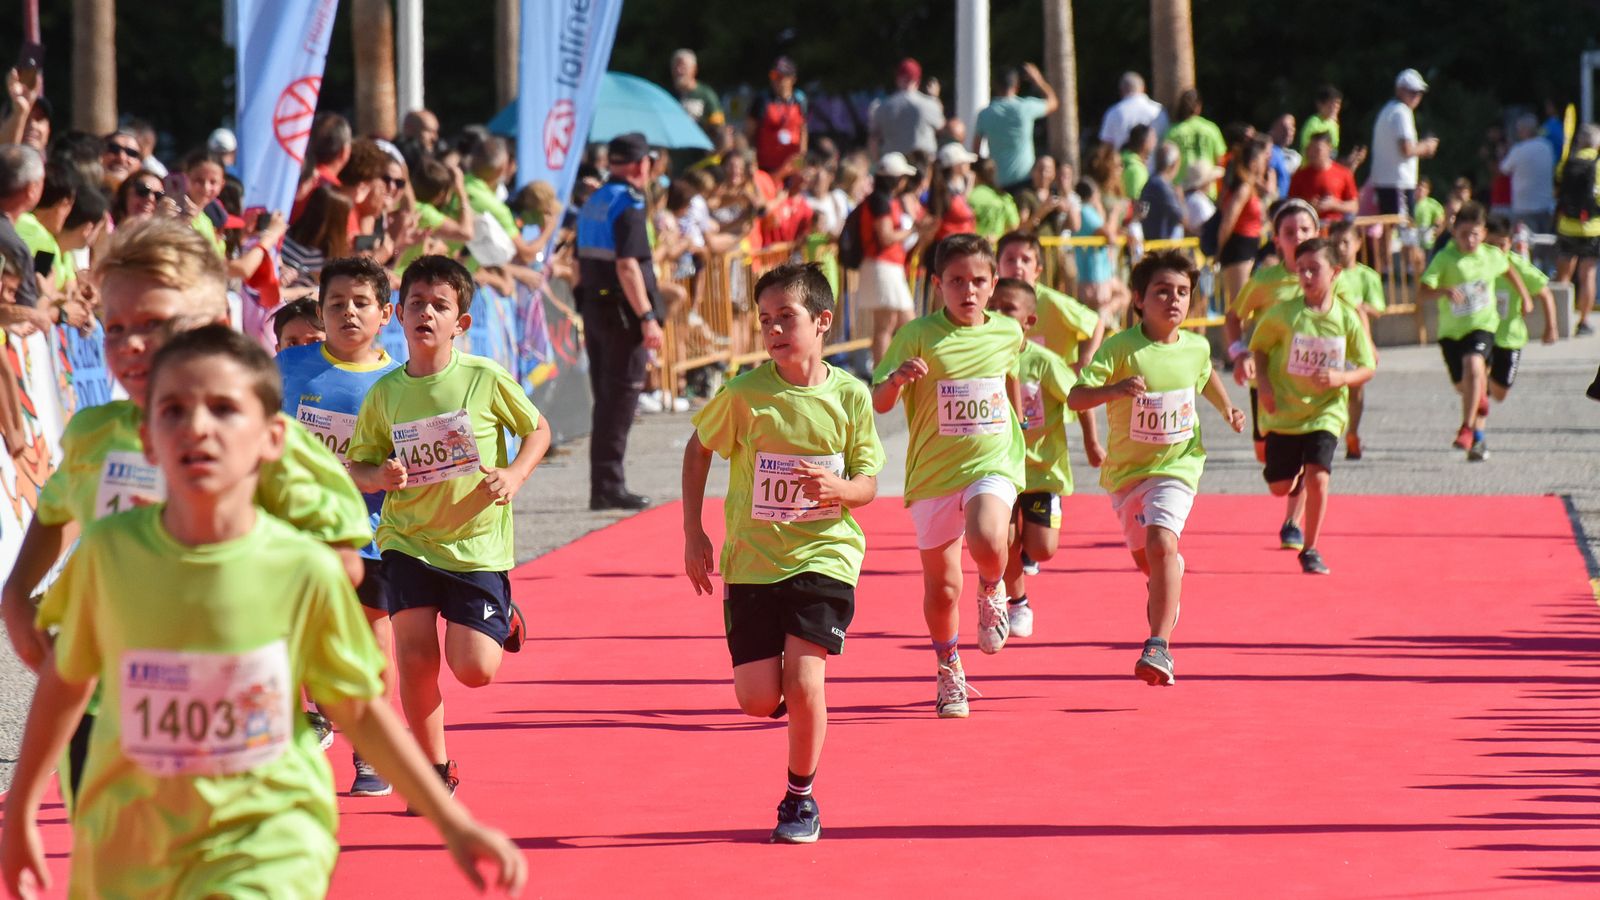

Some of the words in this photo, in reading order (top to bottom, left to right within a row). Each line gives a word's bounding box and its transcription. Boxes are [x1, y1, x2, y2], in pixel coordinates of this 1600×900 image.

[1294, 349, 1327, 368] 1432
[301, 410, 316, 424] XXI
[943, 399, 989, 420] 1206
[1137, 410, 1177, 430] 1011
[393, 429, 405, 440] XXI
[400, 440, 448, 469] 1436
[760, 458, 776, 470] XXI
[760, 477, 801, 503] 107
[134, 696, 235, 742] 1403
